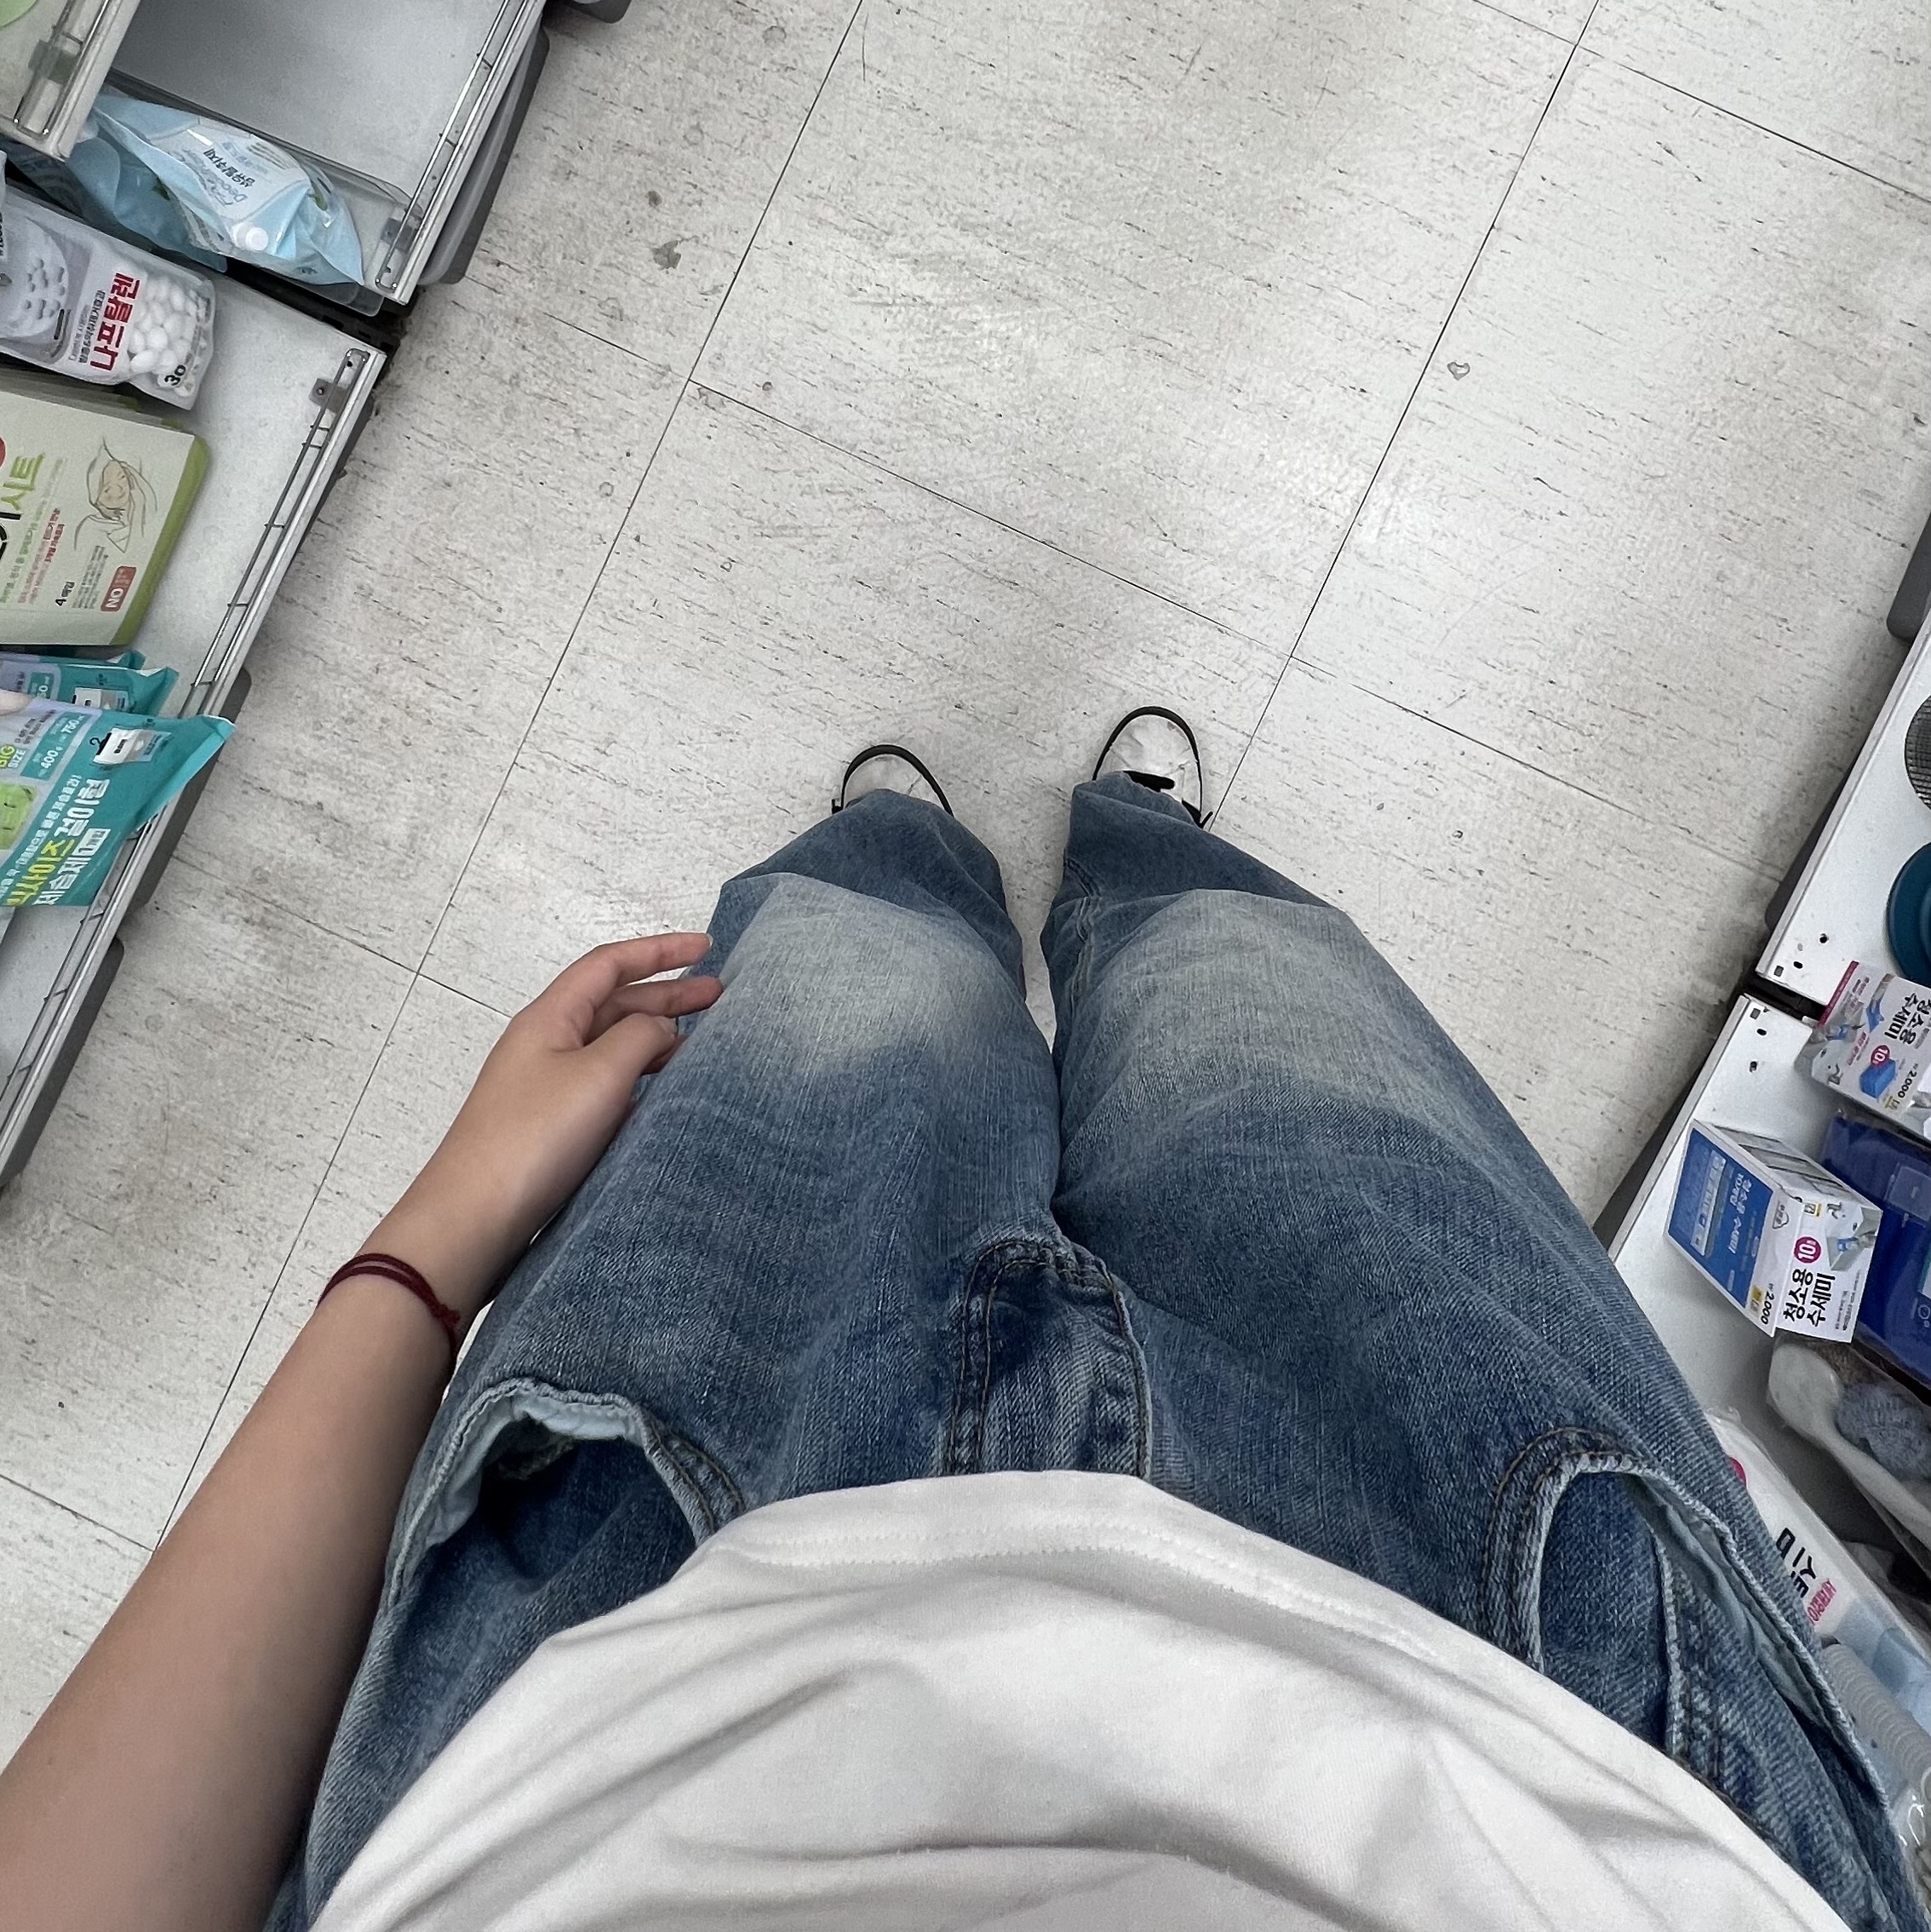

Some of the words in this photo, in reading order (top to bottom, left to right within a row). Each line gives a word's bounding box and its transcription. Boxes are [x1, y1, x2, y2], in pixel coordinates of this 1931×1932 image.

[90, 272, 140, 371] 나프탈렌
[54, 778, 111, 838] 걸이형
[1884, 993, 1918, 1039] 수세미
[1783, 1268, 1814, 1321] 청소용
[1807, 1272, 1836, 1327] 수세미
